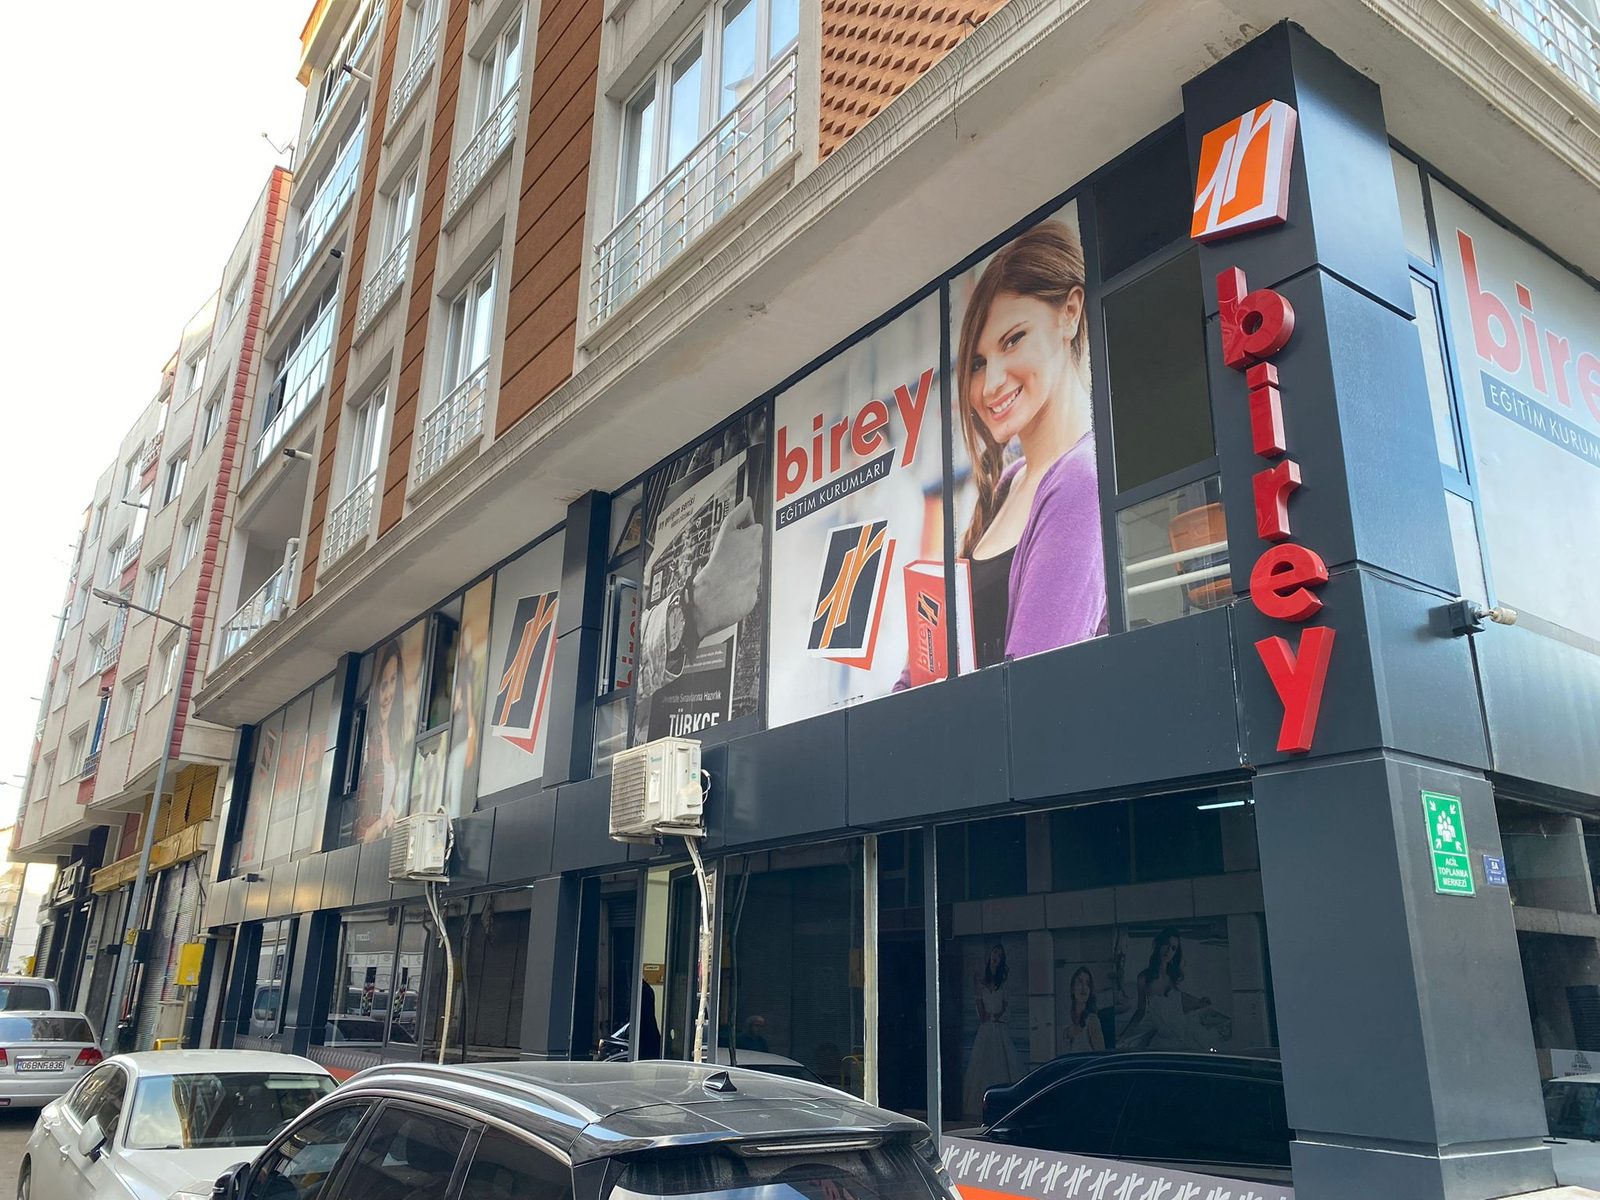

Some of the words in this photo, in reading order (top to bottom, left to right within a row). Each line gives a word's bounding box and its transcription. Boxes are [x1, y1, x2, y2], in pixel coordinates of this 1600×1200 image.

[776, 367, 935, 503] birey
[1490, 383, 1546, 432] EĞİTİM
[780, 497, 816, 525] EĞİTİM
[819, 460, 885, 502] KURUMLARI
[1216, 265, 1336, 753] birey
[1438, 866, 1468, 878] TOPLANMA
